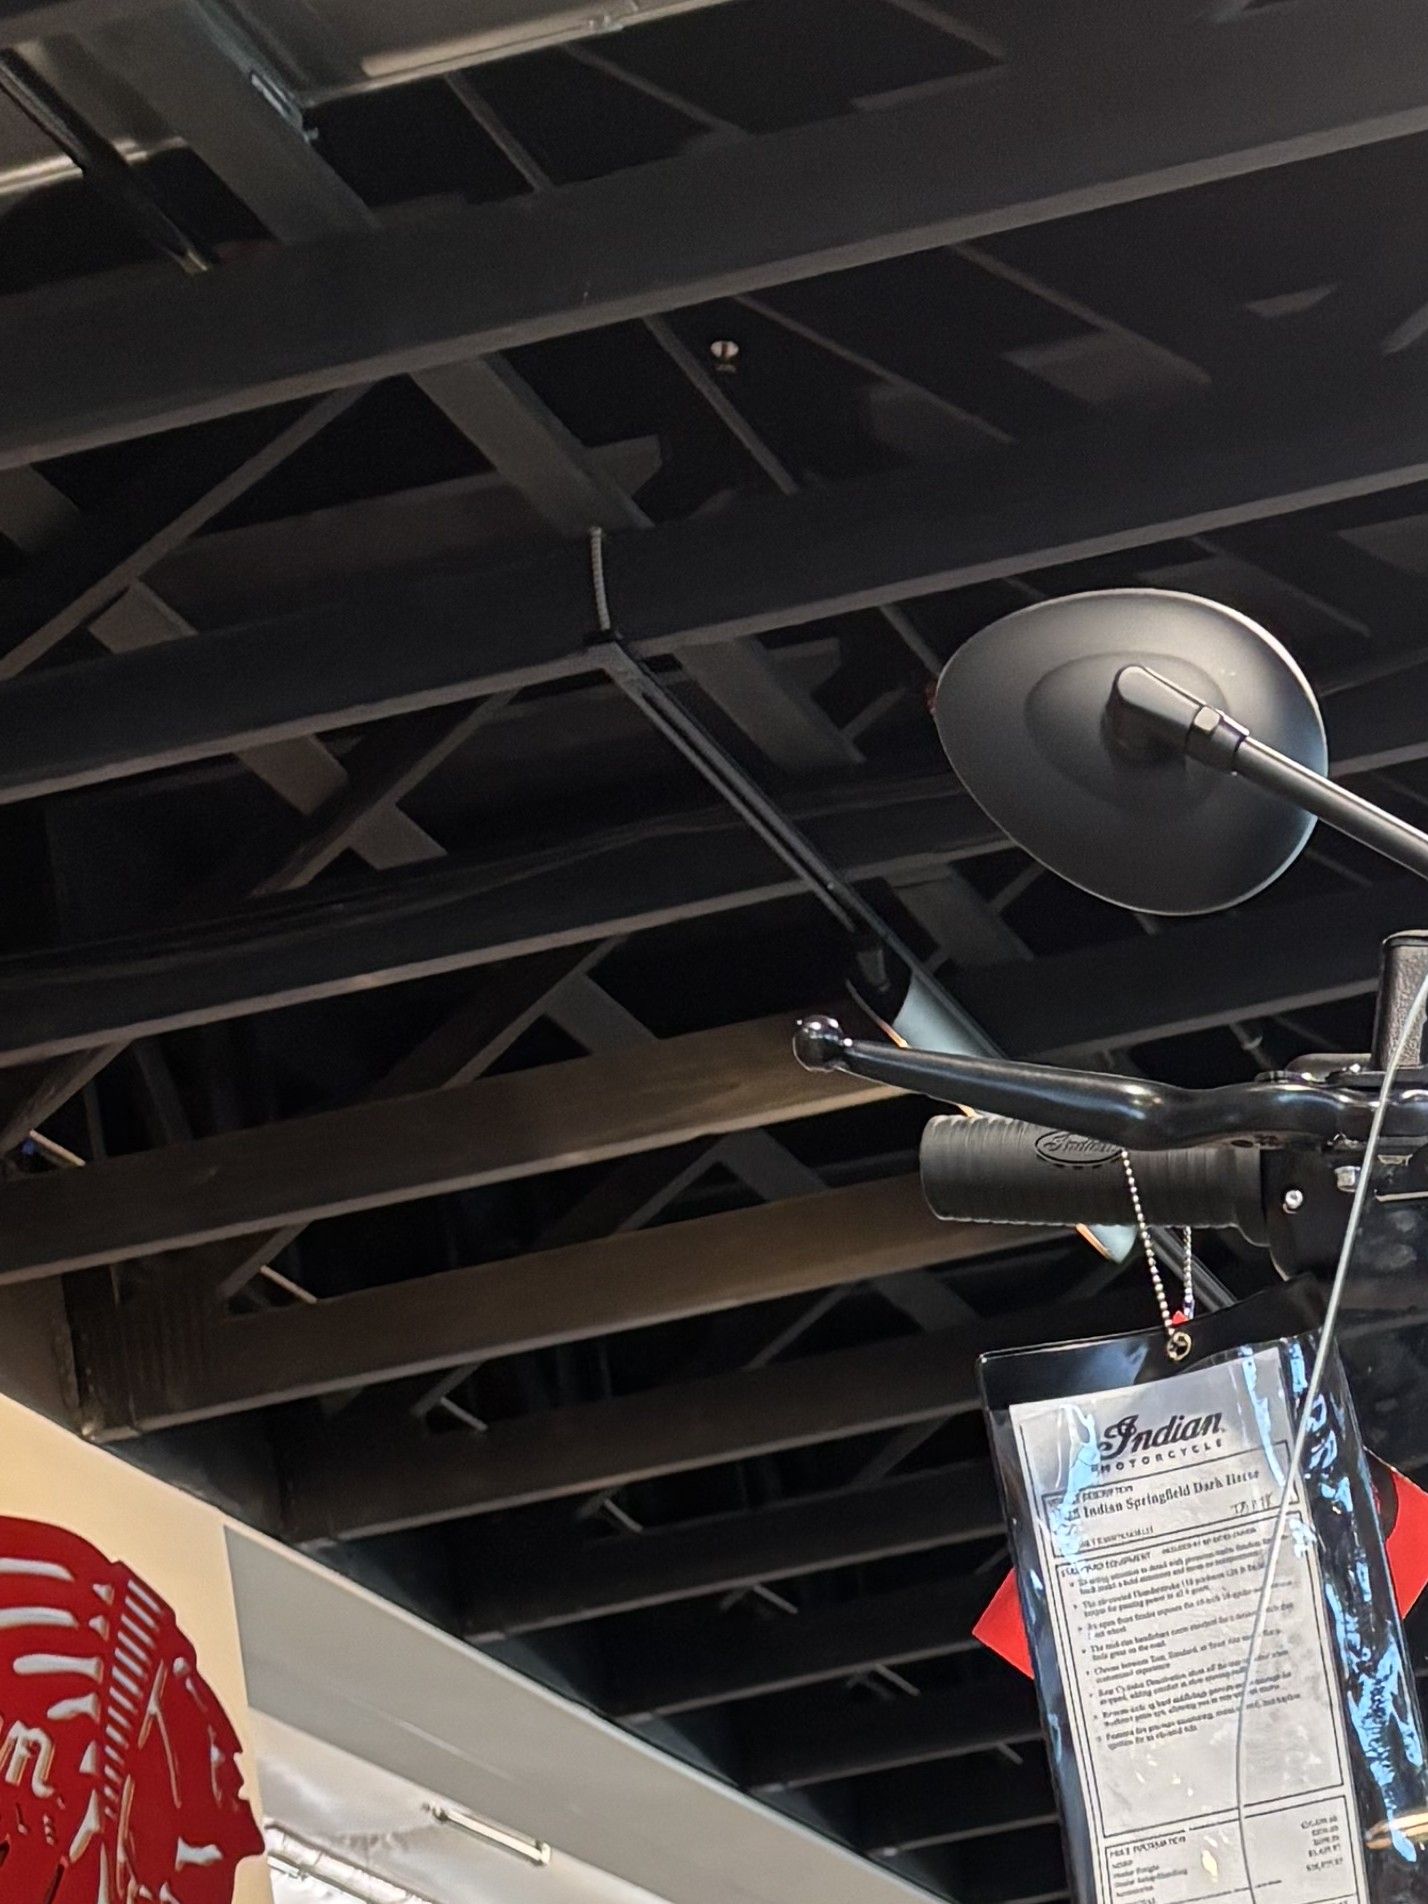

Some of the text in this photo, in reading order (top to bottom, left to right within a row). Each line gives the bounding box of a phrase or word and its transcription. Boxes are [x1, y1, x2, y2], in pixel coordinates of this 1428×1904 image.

[1098, 1411, 1223, 1461] Indian
[1099, 1438, 1223, 1474] MOTORCYCLE
[1083, 1502, 1124, 1519] Indian
[1126, 1485, 1191, 1510] Springfield
[1193, 1478, 1224, 1494] Dark
